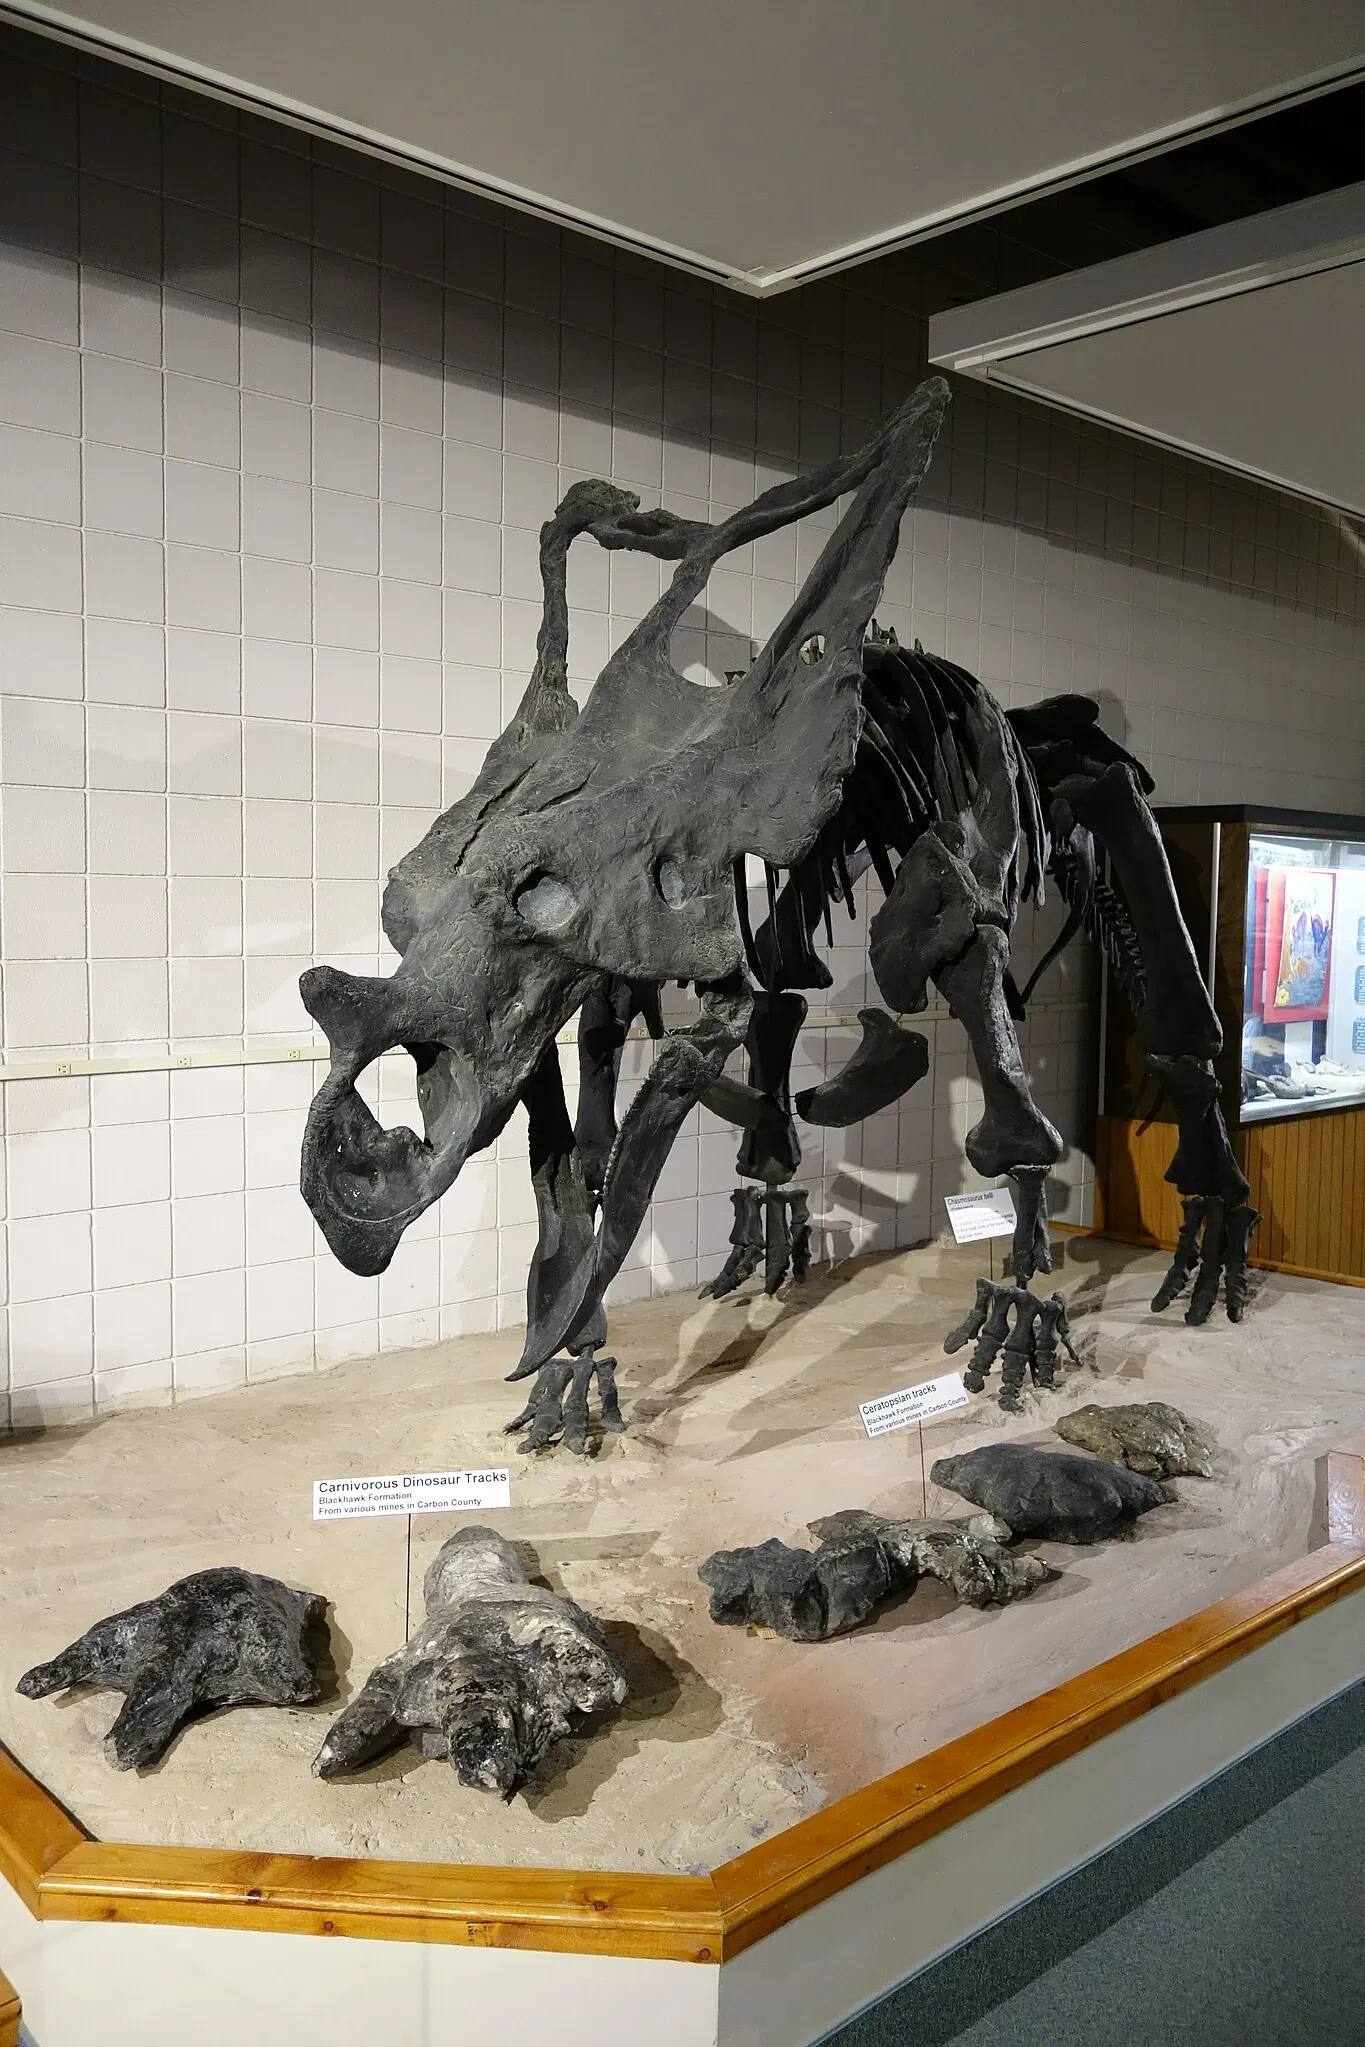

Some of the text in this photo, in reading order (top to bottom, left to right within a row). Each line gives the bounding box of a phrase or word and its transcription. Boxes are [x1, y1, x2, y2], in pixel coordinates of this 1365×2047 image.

[862, 1384, 936, 1414] Ceratopsian tracks
[866, 1402, 924, 1426] Blackhawk Formation
[870, 1424, 886, 1434] From
[886, 1418, 906, 1429] various
[906, 1412, 922, 1422] mines
[928, 1402, 948, 1413] Carbon
[948, 1396, 966, 1406] County
[319, 1472, 506, 1493] Carnivorous Dinosaur Tracks
[318, 1492, 412, 1505] Blackhawk Formation
[318, 1498, 482, 1515] From various mines in Carbon County
